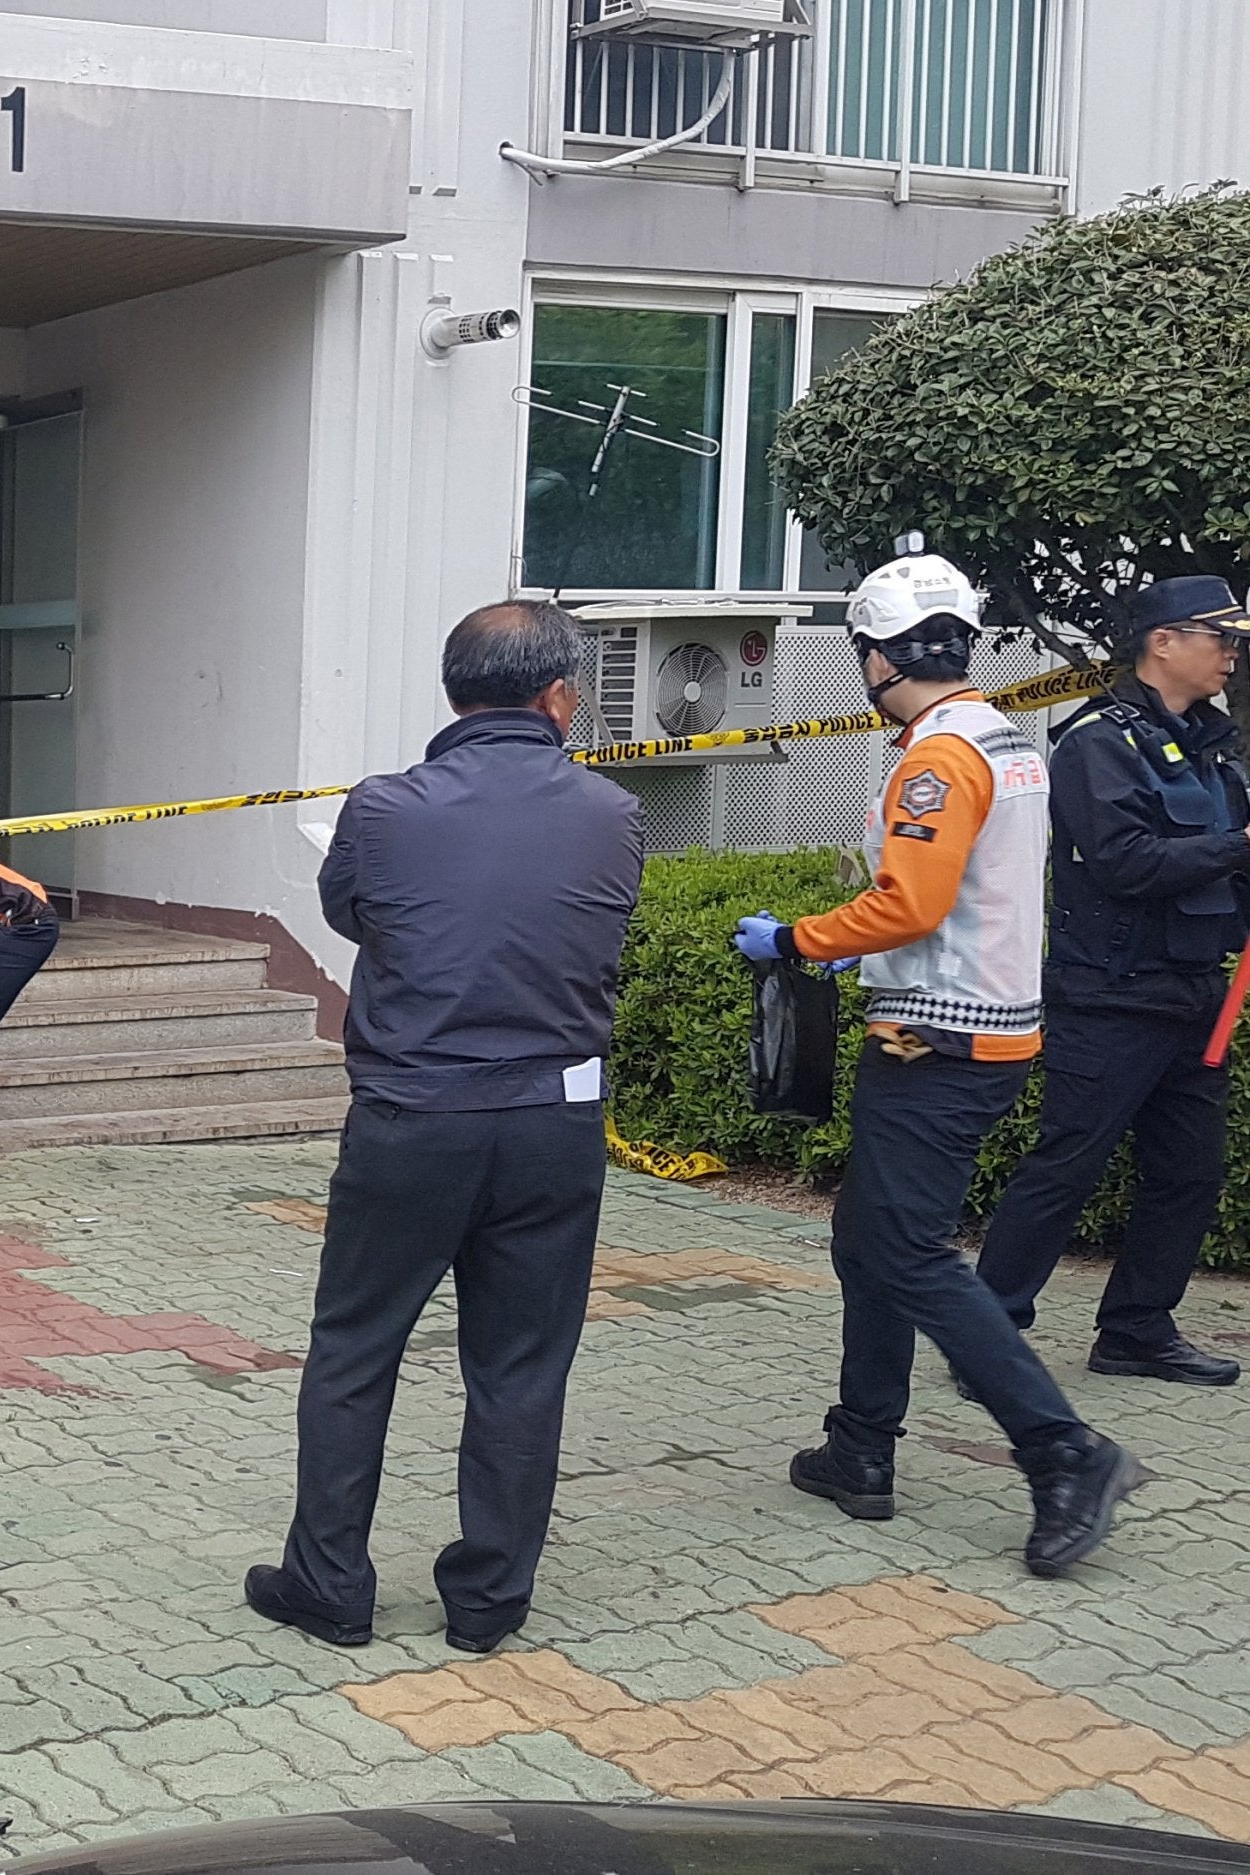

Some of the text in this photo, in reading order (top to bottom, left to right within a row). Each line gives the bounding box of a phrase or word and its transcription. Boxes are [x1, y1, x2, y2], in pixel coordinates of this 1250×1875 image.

[0, 87, 26, 173] 1
[741, 671, 763, 688] LG
[818, 710, 874, 734] POLICE
[586, 737, 694, 764] POLICE LINE
